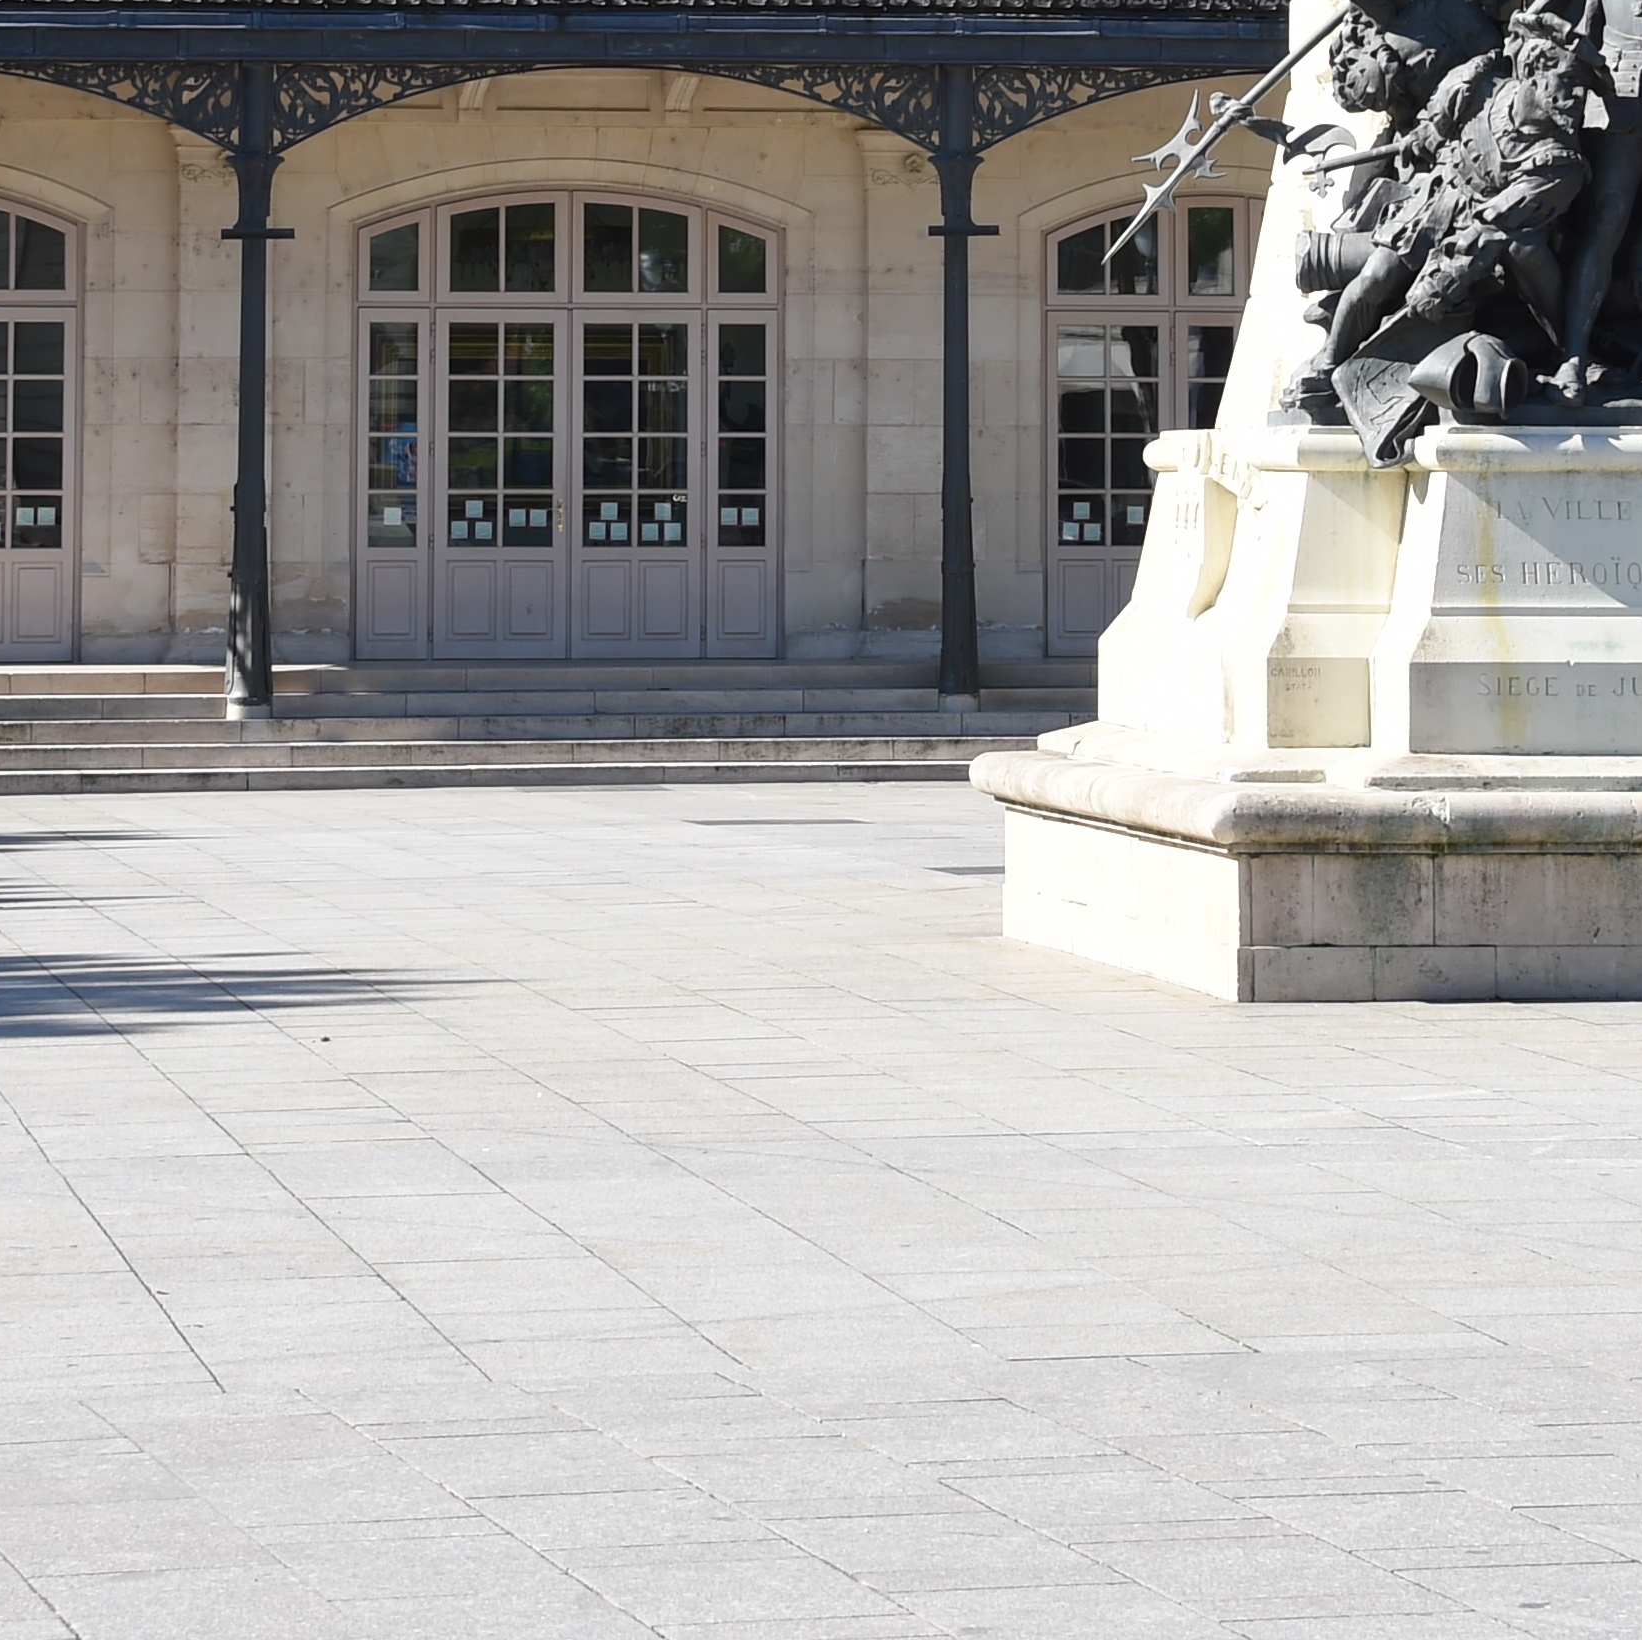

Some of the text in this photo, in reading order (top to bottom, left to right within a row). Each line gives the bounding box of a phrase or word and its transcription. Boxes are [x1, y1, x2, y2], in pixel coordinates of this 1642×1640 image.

[1541, 496, 1632, 521] VILLE
[1457, 563, 1506, 585] SES
[1477, 672, 1559, 697] SIEGE
[1576, 683, 1598, 697] DE
